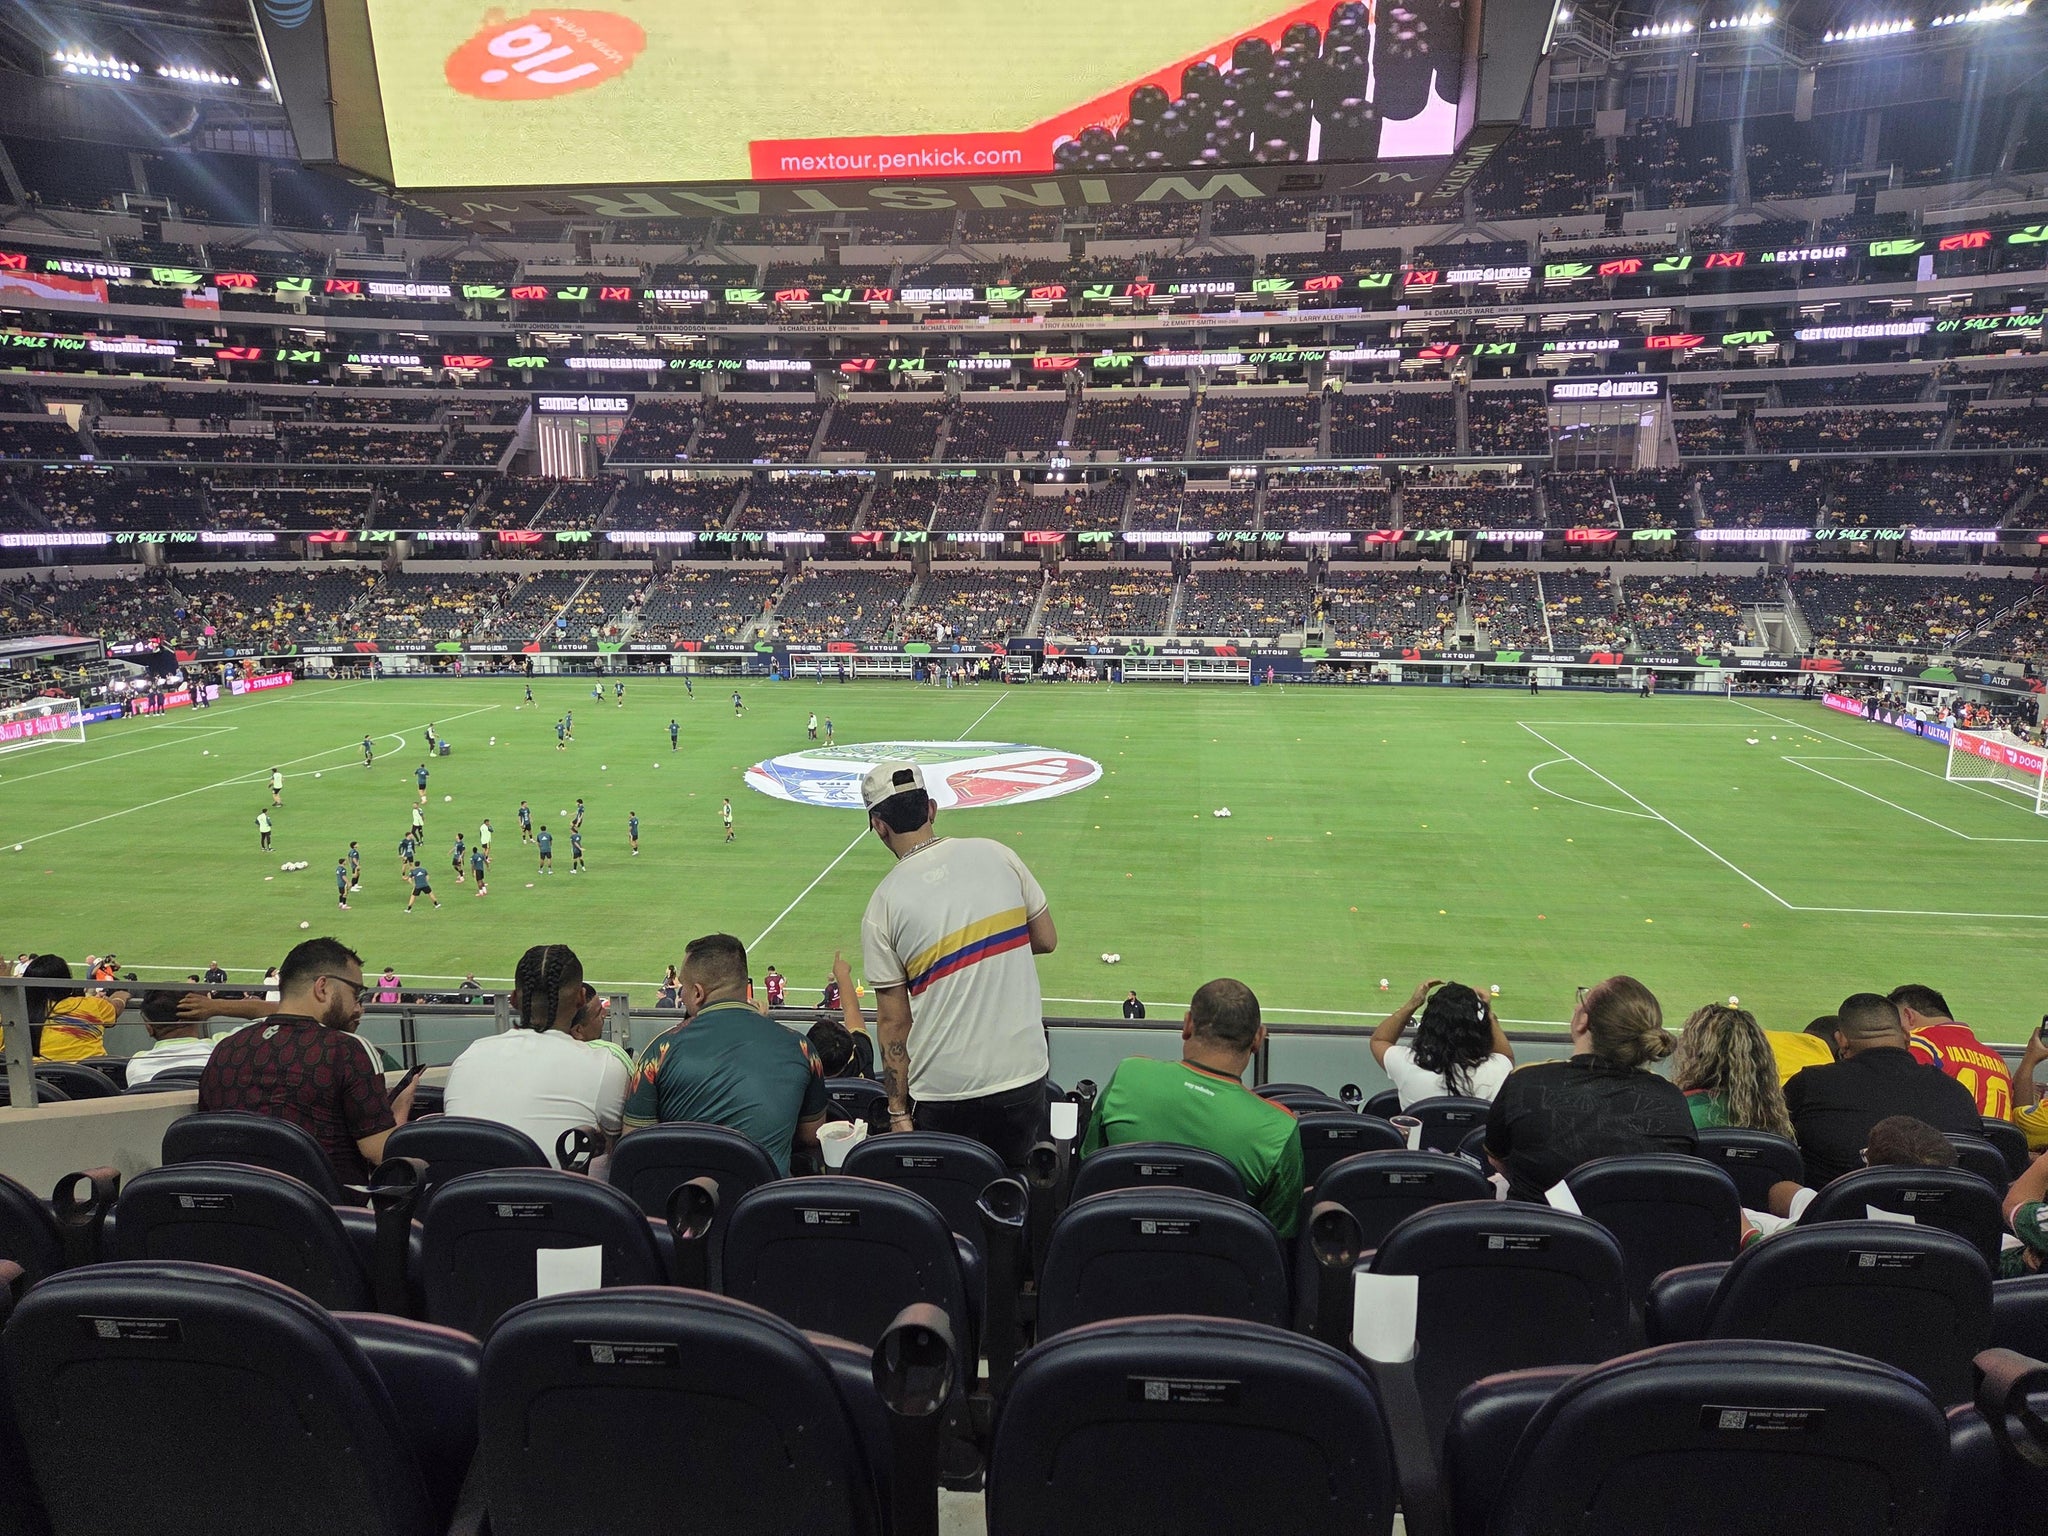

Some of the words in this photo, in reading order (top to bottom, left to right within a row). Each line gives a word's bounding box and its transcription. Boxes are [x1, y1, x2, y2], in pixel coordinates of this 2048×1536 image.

[780, 147, 1022, 172] mextour.penkick.com
[568, 173, 1266, 218] WINSTAR
[1761, 246, 1846, 262] MEXTOUR
[46, 260, 131, 278] MEXTOUR
[1168, 282, 1235, 293] MEXTOUR
[644, 290, 708, 300] MEXTOUR
[1936, 320, 1960, 332] ON
[1962, 318, 2003, 330] SALE
[2006, 314, 2044, 327] NOW
[1802, 328, 1822, 340] GET
[1823, 327, 1852, 339] YOUR
[1853, 325, 1884, 337] GEAR
[12, 337, 48, 348] SALE
[54, 338, 85, 350] NOW
[1542, 340, 1620, 351] MEXTOUR
[348, 354, 420, 365] MEXTOUR
[1149, 356, 1164, 366] GET
[1164, 355, 1187, 366] YOUR
[1250, 353, 1266, 362] ON
[1268, 352, 1297, 362] SALE
[1299, 351, 1325, 361] NOW
[570, 358, 586, 368] GET
[586, 358, 609, 368] YOUR
[670, 360, 686, 369] ON
[688, 360, 715, 369] SALE
[718, 360, 742, 369] NOW
[948, 359, 1011, 368] MEXTOUR
[4, 534, 20, 546] GET
[22, 534, 46, 546] YOUR
[116, 533, 134, 543] ON
[138, 532, 168, 543] SALE
[170, 532, 198, 542] NOW
[417, 532, 480, 540] MEXTOUR
[611, 532, 625, 542] GET
[625, 532, 646, 542] YOUR
[699, 532, 714, 542] ON
[716, 532, 739, 542] SALE
[742, 532, 763, 542] NOW
[947, 533, 1005, 542] MEXTOUR
[1127, 532, 1141, 542] GET
[1142, 532, 1162, 542] YOUR
[1216, 532, 1232, 541] ON
[1234, 532, 1259, 541] SALE
[1261, 532, 1285, 541] NOW
[1476, 531, 1544, 541] MEXTOUR
[1701, 529, 1718, 540] GET
[1720, 529, 1745, 540] YOUR
[1745, 529, 1771, 540] GEAR
[1815, 530, 1835, 540] ON
[1838, 530, 1871, 540] SALE
[1874, 529, 1906, 540] NOW
[1854, 664, 1903, 672] MEXTOUR
[253, 678, 283, 689] STRAUSS
[1992, 678, 2010, 686] AT&T
[1928, 726, 1949, 741] ULTRA
[1979, 742, 1991, 756] ria
